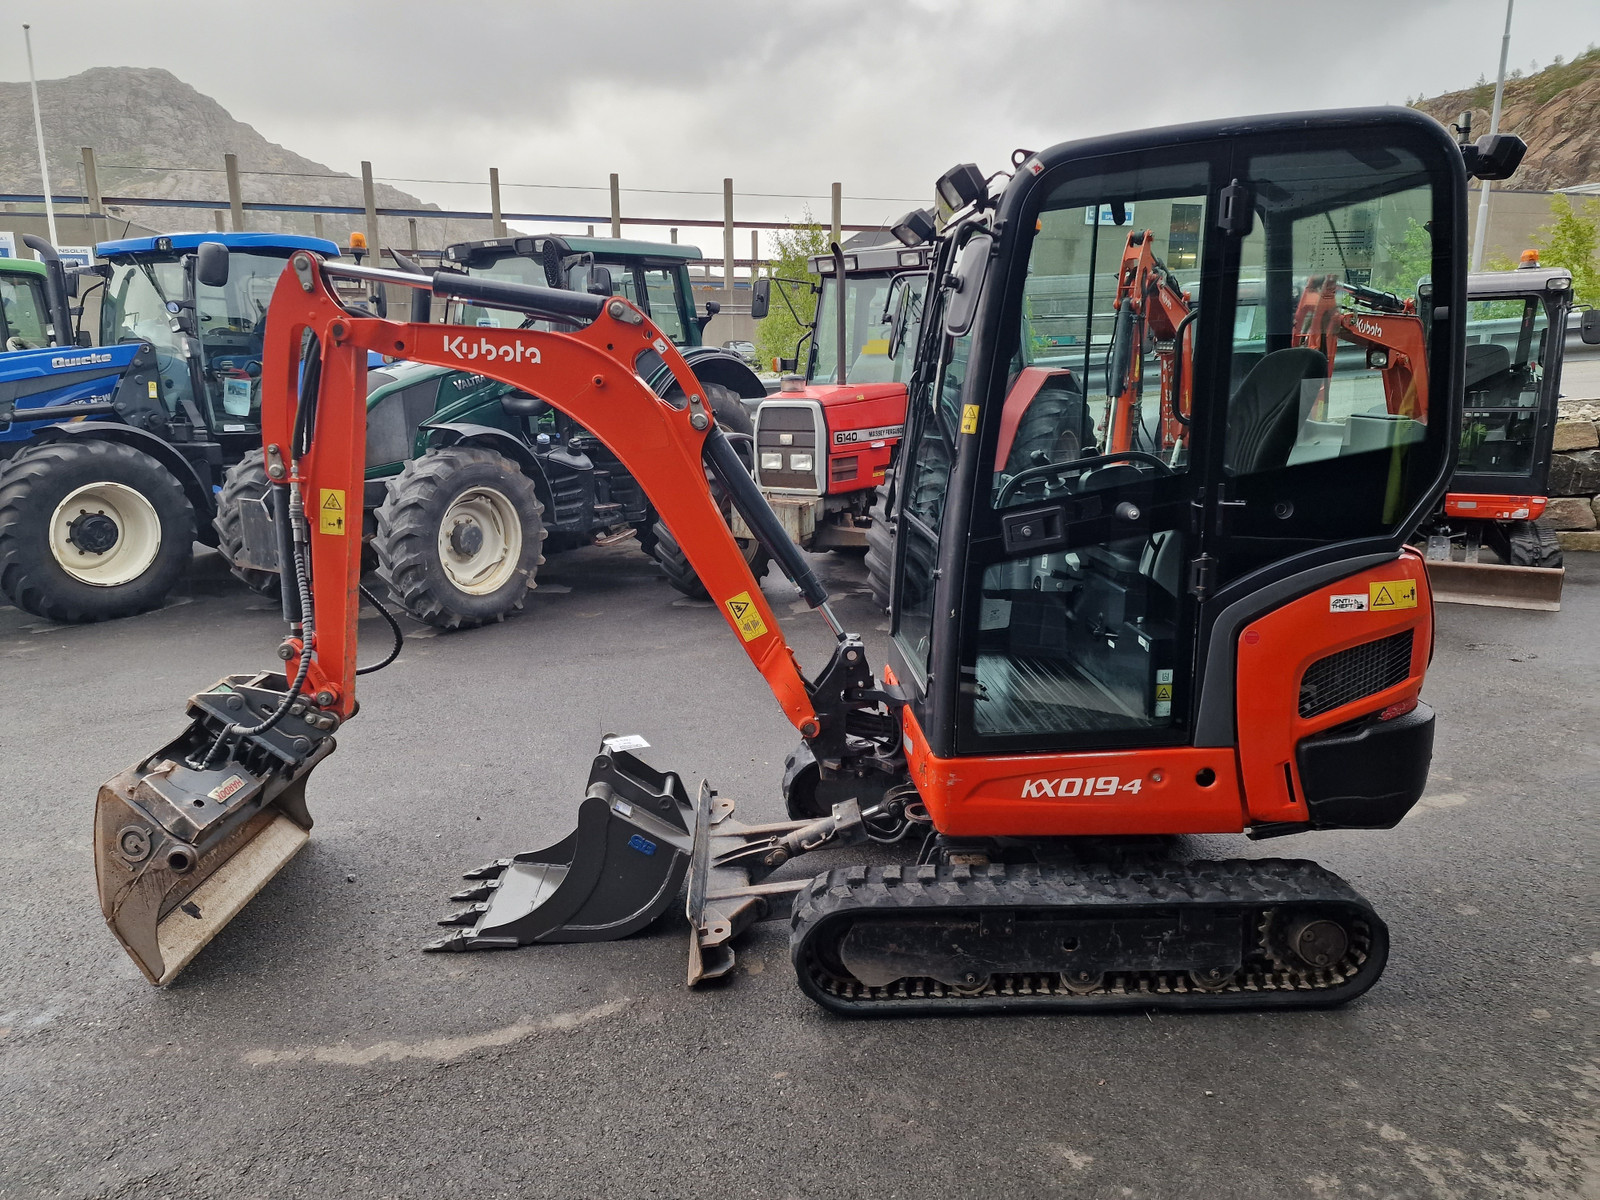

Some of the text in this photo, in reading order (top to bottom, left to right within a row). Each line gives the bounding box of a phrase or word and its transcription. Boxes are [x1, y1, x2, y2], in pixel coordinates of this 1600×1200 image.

[1356, 318, 1382, 337] Kubota
[443, 335, 541, 364] Kubota
[51, 353, 112, 369] Quicke
[453, 374, 487, 391] VALTRA
[836, 432, 858, 443] 6140
[868, 427, 903, 437] MASSEY FERGUSO
[215, 778, 244, 802] HARDOX
[1021, 776, 1143, 798] KX019-4
